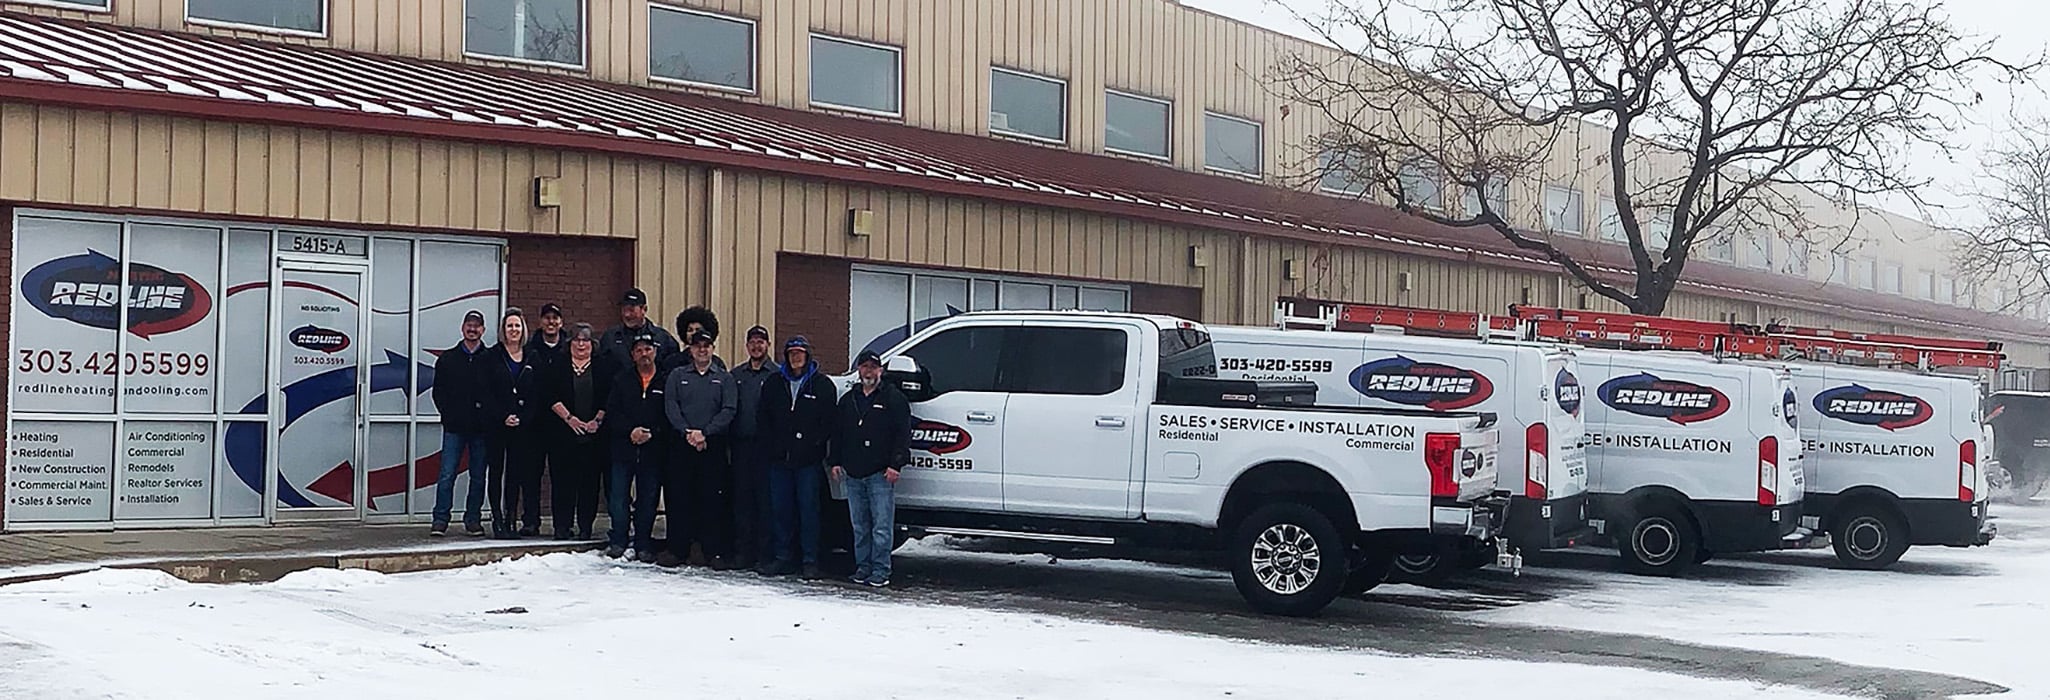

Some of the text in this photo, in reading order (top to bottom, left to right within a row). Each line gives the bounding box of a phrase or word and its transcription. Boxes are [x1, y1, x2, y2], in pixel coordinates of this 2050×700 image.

[293, 236, 346, 254] 5415-A
[49, 281, 186, 309] REDLINE
[298, 335, 342, 344] REDLINE
[1220, 358, 1333, 373] 303-420-5599
[1368, 375, 1474, 393] REDLINE
[1615, 389, 1713, 408] REDLINE
[1829, 399, 1917, 415] REDLINE
[1159, 414, 1415, 438] SALES SERVICE INSTALLATION
[20, 432, 58, 443] Heating
[128, 431, 206, 442] Air Conditioning
[1159, 429, 1219, 442] Residential
[1345, 438, 1414, 451] Commercial
[1616, 435, 1731, 453] INSTALLATION
[1830, 441, 1934, 457] INSTALLATION
[20, 448, 74, 457] Residential
[128, 447, 185, 457] Commercial
[20, 464, 106, 474] New Construction
[128, 463, 175, 472] Remodels
[19, 480, 77, 490] Commercial
[128, 478, 203, 488] Realtor Services
[19, 496, 92, 506] Sales & Service
[128, 494, 180, 503] Installation
